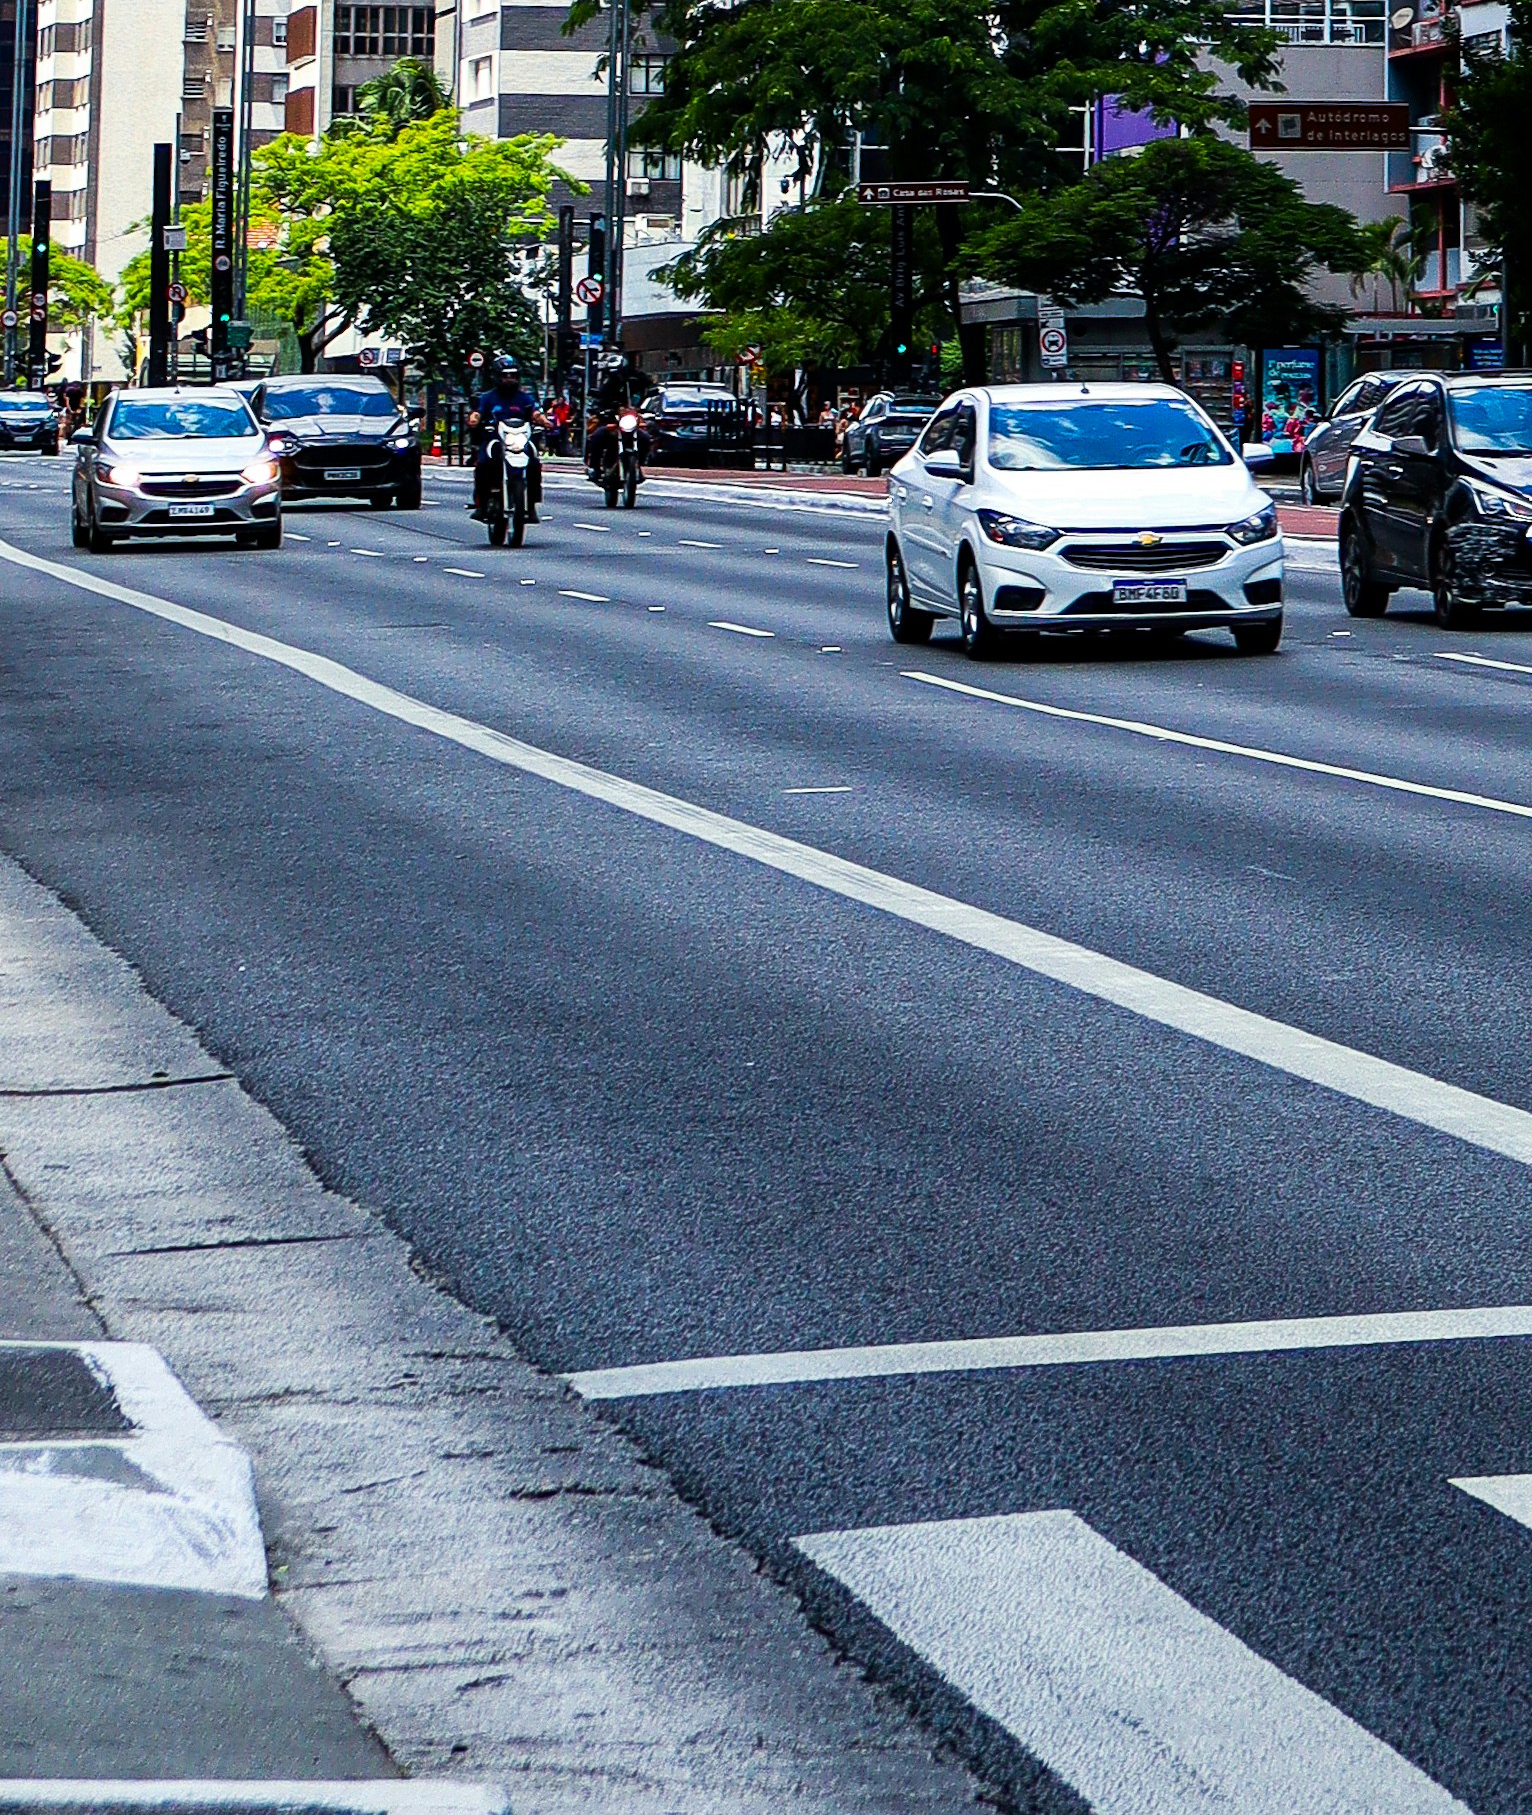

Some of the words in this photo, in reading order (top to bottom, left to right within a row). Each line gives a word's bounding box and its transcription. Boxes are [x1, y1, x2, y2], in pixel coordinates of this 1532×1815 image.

[1306, 110, 1390, 123] Autódromo
[1306, 130, 1323, 141] de
[1329, 130, 1406, 144] Interlagos
[215, 136, 230, 199] Figueiredo
[215, 201, 227, 235] Maria
